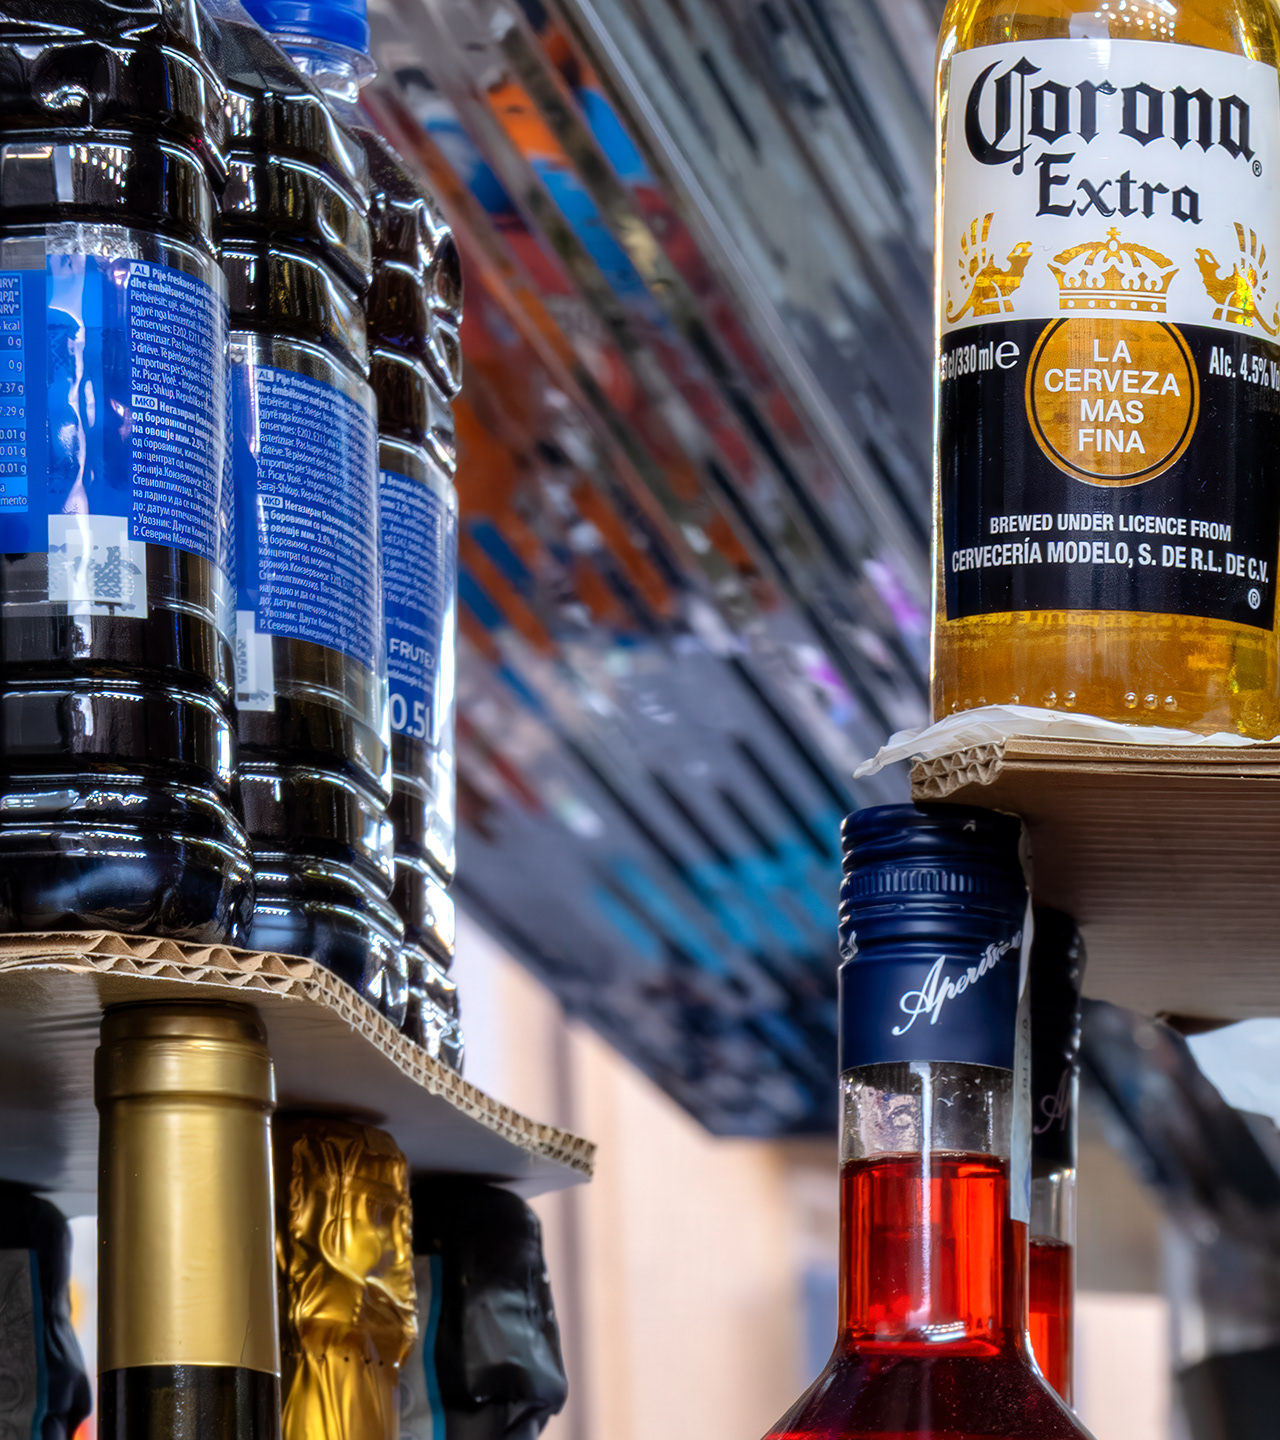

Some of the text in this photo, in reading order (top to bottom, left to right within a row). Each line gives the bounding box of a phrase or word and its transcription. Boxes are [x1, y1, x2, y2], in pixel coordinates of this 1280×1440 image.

[965, 56, 1255, 175] Corona
[1035, 153, 1202, 225] Extra
[1093, 339, 1132, 364] LA
[1209, 346, 1269, 387] Alc. 4.5%
[1044, 368, 1181, 397] CERVEZA
[1080, 399, 1144, 424] MAS
[1078, 429, 1146, 454] FINA
[990, 514, 1231, 542] BREWED UNDER LICENCE FROM
[952, 538, 1269, 583] CERVECERÍA MODELO, S. DE R.L. DE C.V.
